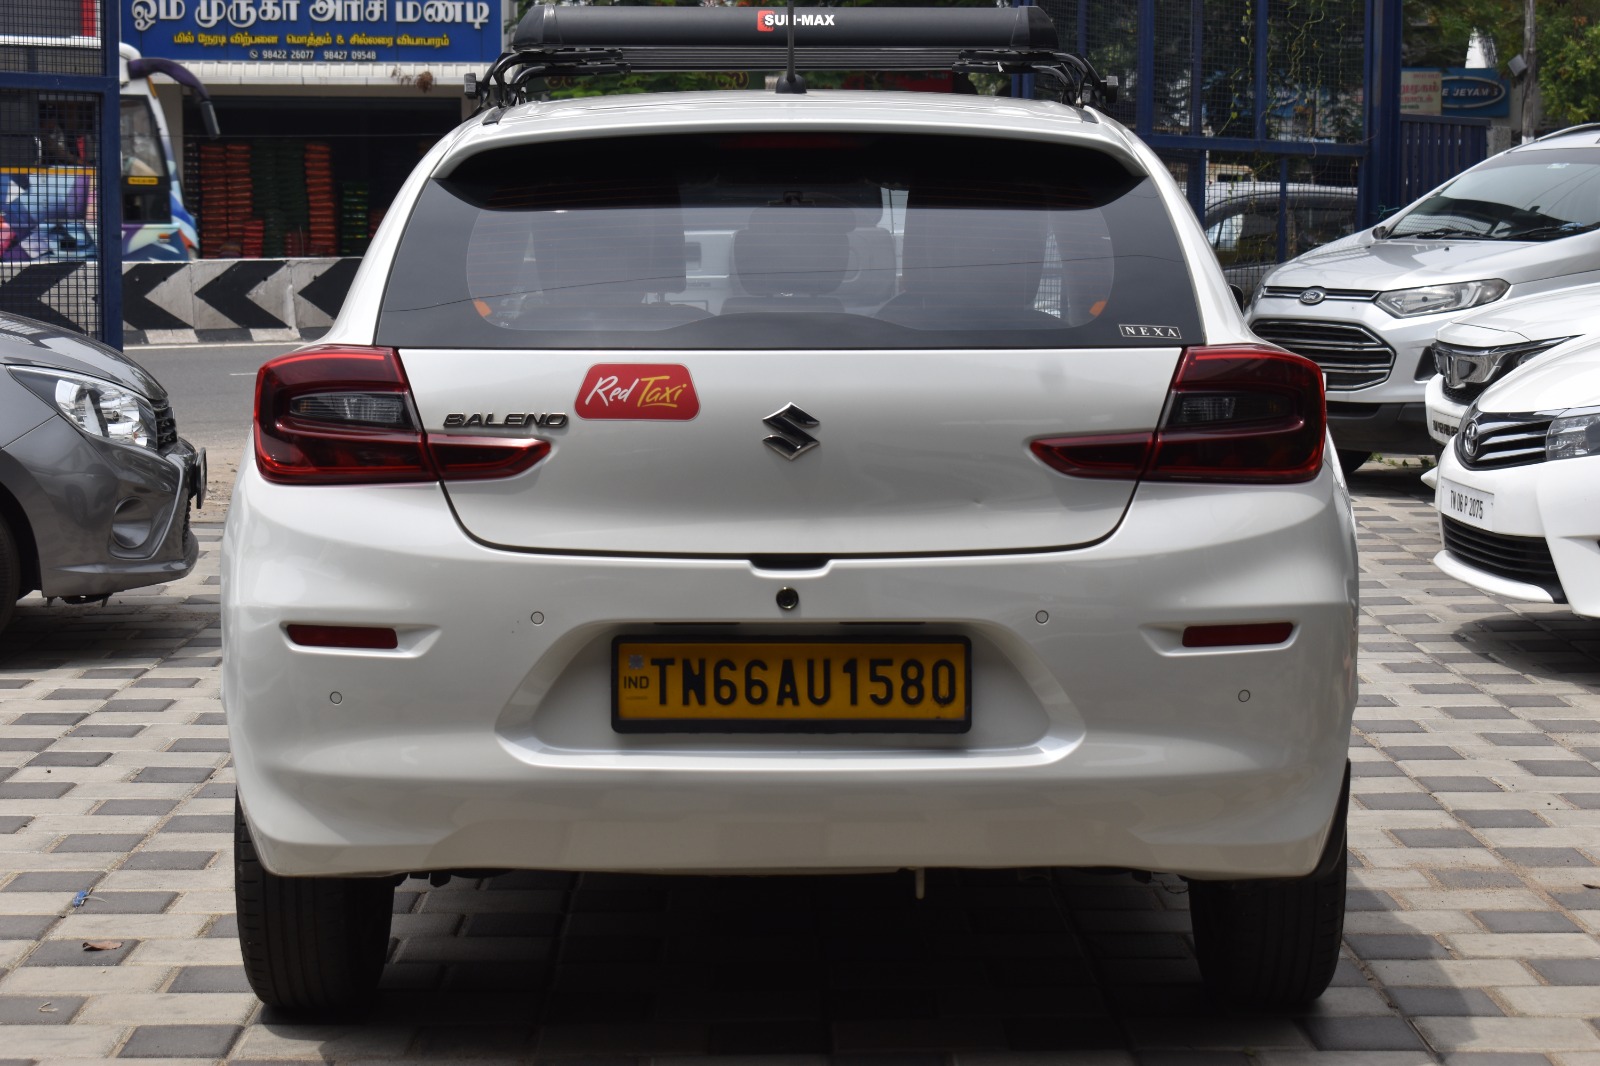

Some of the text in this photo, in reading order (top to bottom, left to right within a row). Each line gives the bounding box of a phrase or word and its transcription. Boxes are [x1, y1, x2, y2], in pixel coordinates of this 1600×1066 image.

[195, 0, 300, 28] முருகா
[173, 31, 449, 48] மில் நேரடி விற்பனை மொத்தம் & சில்லரை வியாபாரம்
[262, 50, 287, 59] 98422
[291, 50, 314, 59] 26077
[323, 50, 347, 60] 98427
[1125, 326, 1177, 337] NEXA
[585, 375, 687, 408] Red Taxi
[443, 412, 569, 428] BALENO
[624, 658, 957, 706] IND TN66AU1580
